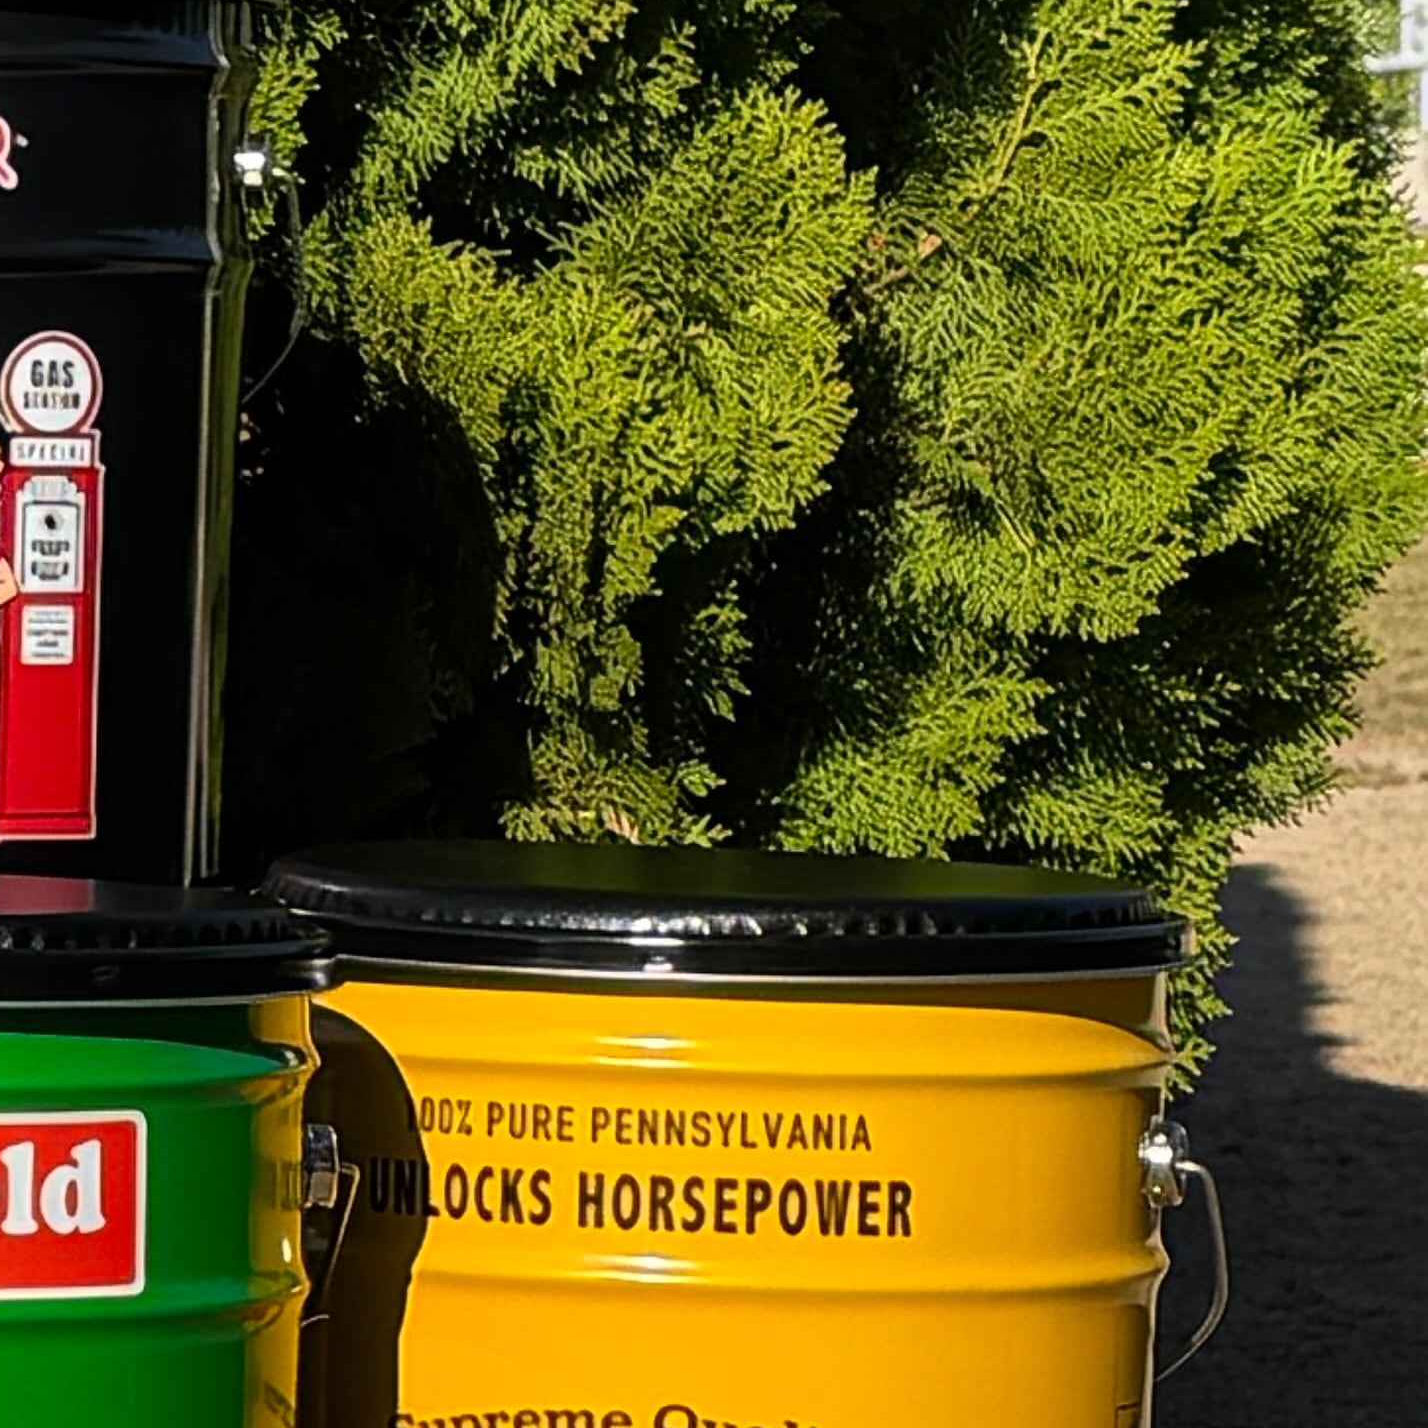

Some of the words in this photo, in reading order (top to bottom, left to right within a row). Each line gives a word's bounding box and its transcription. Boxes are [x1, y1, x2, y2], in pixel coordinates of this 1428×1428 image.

[30, 358, 77, 389] GAS
[486, 1101, 575, 1143] PURE
[590, 1105, 874, 1154] PENNSYLVANIA
[369, 1156, 553, 1227] UNLOCKS
[577, 1174, 914, 1240] HORSEPOWER
